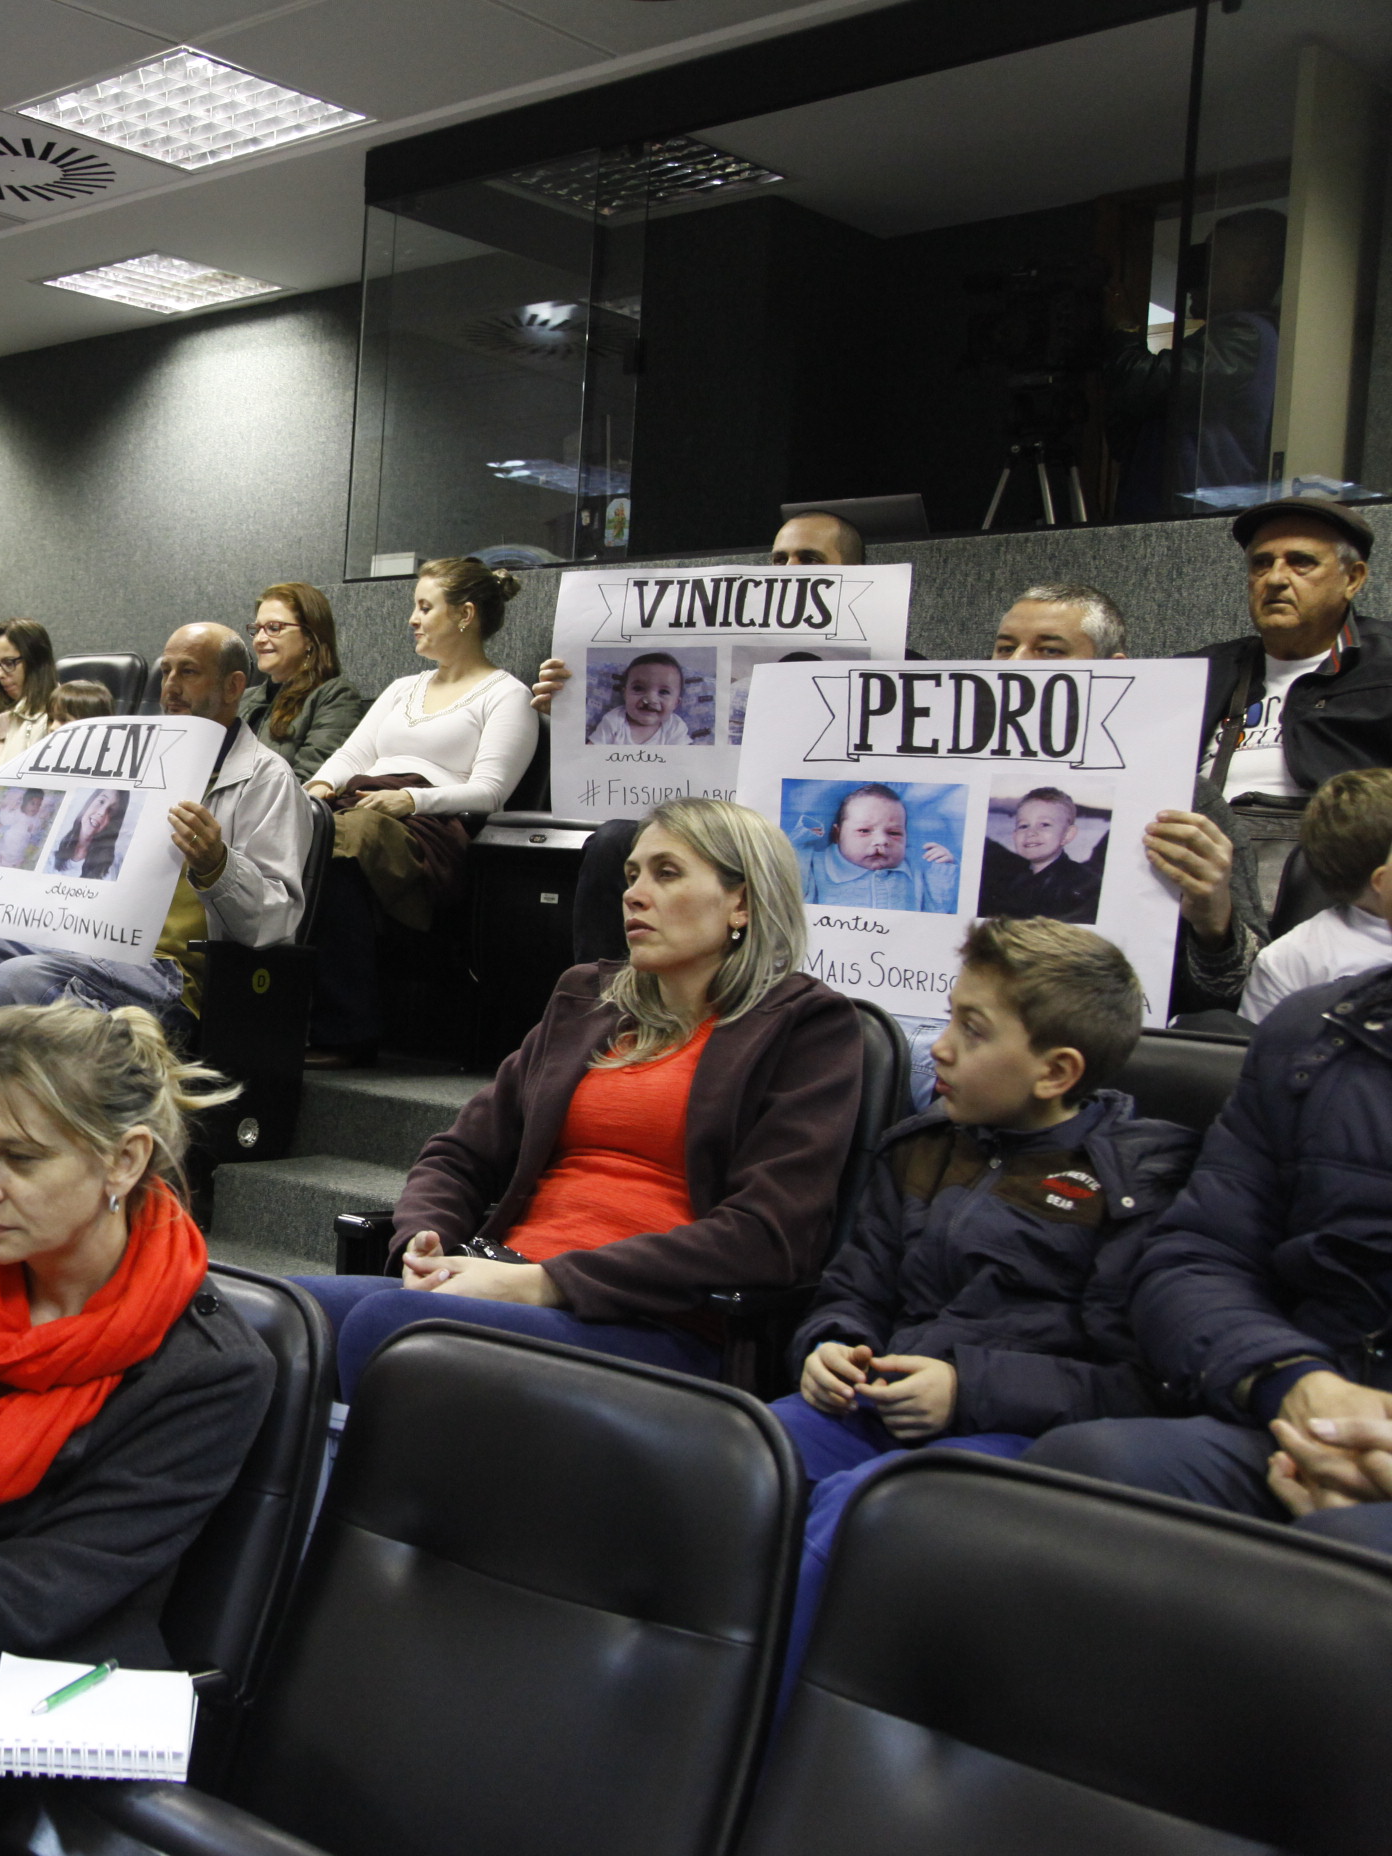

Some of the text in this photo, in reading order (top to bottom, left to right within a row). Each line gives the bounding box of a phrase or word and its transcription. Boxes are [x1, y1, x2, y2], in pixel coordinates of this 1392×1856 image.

[853, 672, 1079, 758] PEDRO
[28, 723, 157, 780] ELLEN
[606, 749, 667, 764] antes
[45, 882, 99, 901] depois
[813, 914, 890, 936] antes
[257, 975, 266, 988] D
